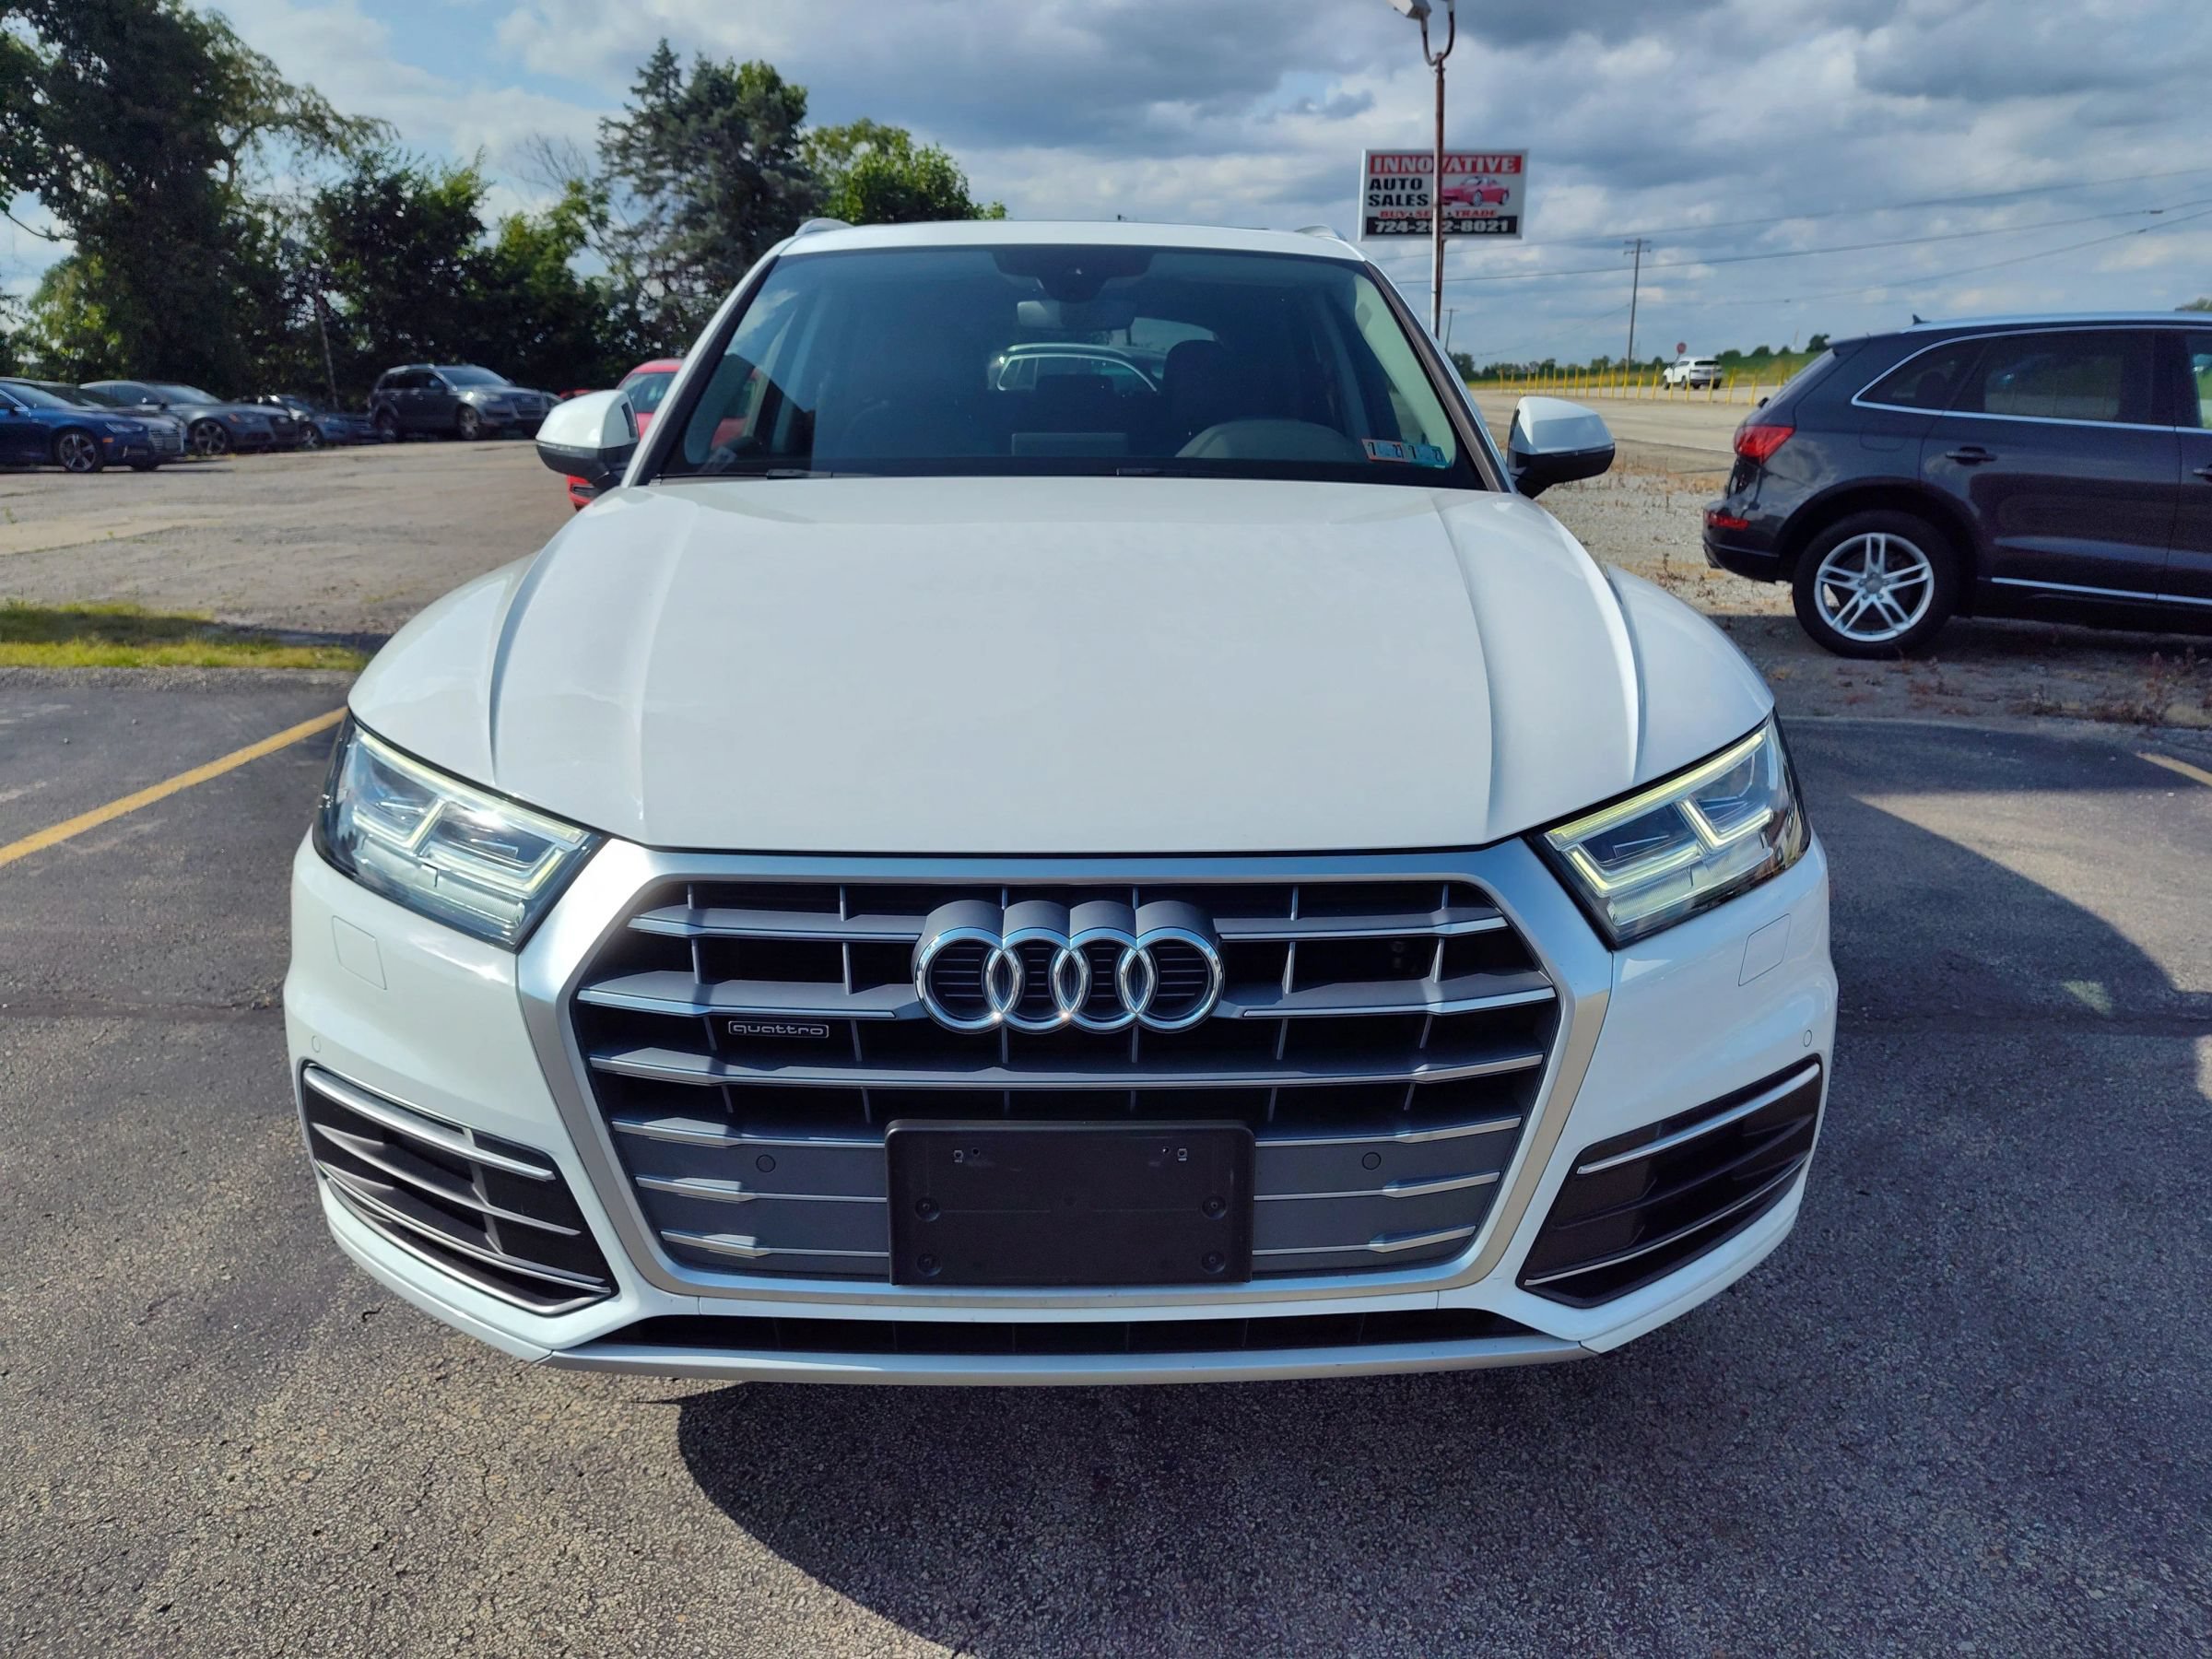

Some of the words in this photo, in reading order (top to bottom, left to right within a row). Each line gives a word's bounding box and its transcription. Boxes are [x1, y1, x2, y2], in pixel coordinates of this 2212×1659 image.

[1370, 177, 1423, 191] AUTO
[1368, 194, 1429, 207] SALES
[1455, 209, 1496, 218] TRADE
[1374, 220, 1509, 232] 724-22-8021
[732, 1024, 825, 1035] quattro
